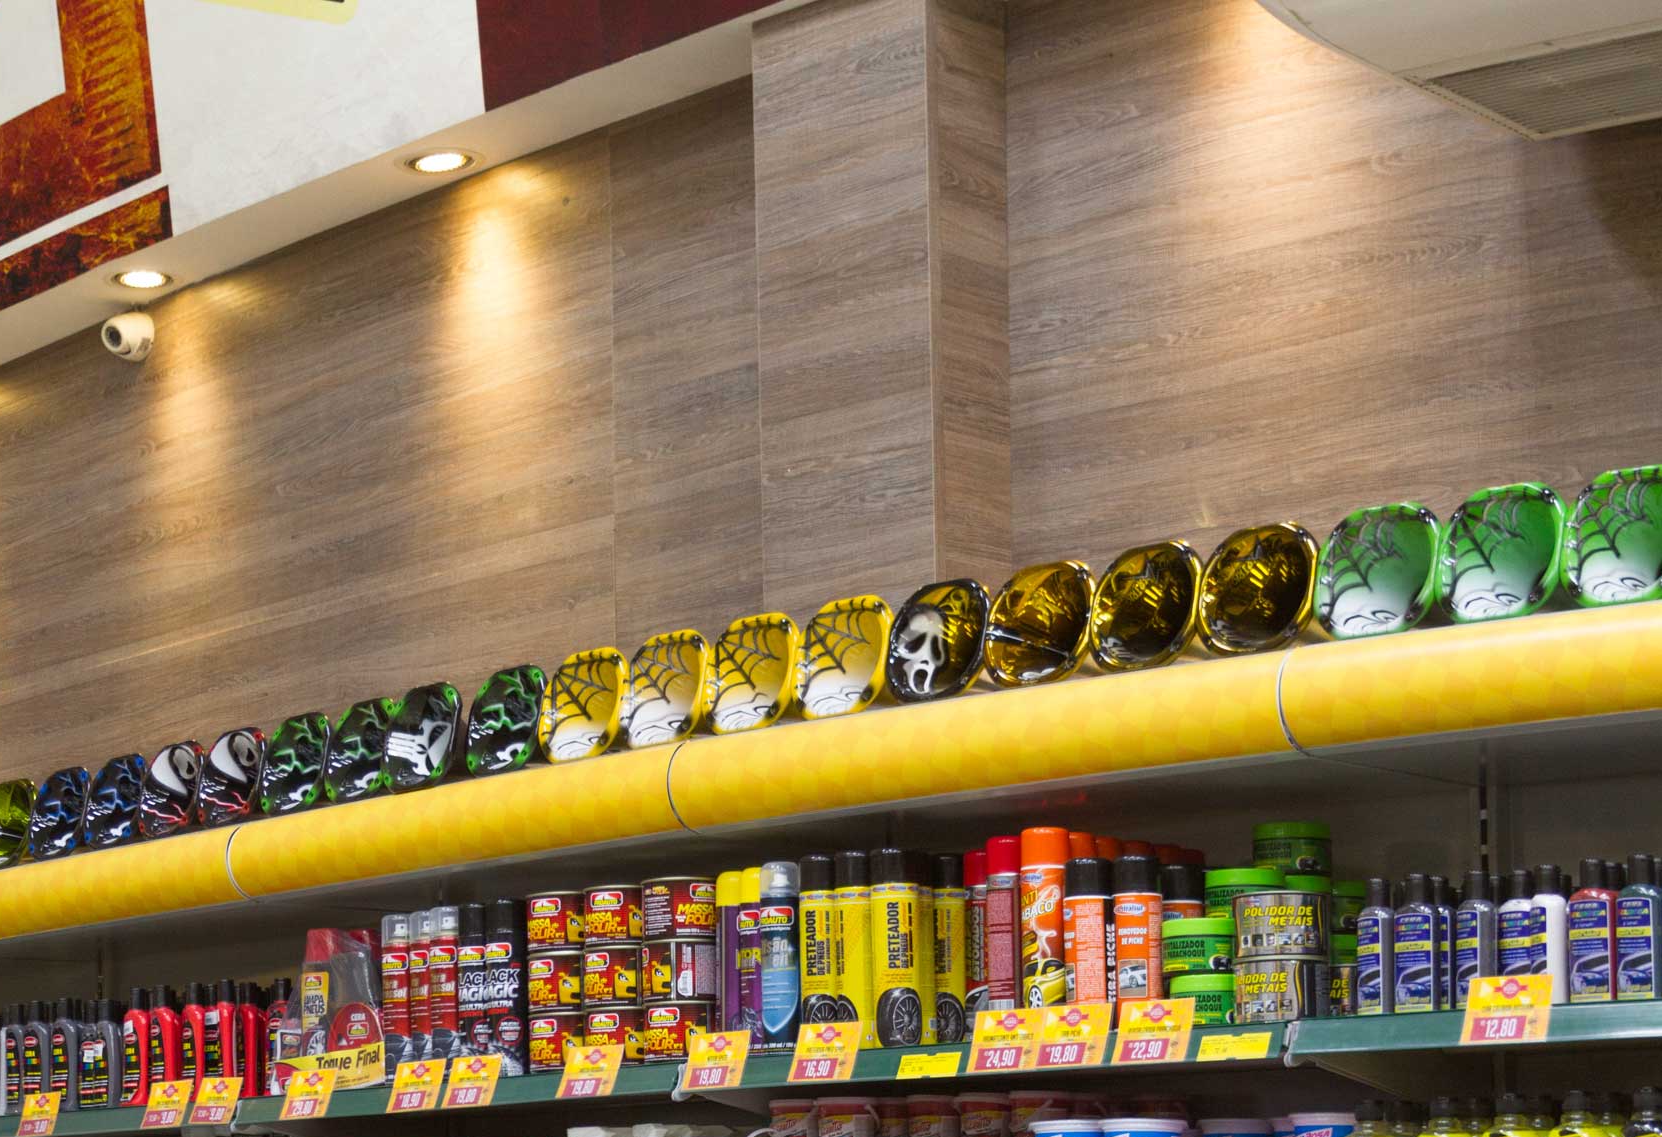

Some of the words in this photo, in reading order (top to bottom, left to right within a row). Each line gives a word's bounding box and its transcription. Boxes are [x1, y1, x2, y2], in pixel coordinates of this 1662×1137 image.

[1022, 900, 1054, 920] ABACO
[1244, 906, 1296, 918] POLIDOR
[1298, 905, 1313, 916] DE
[1269, 916, 1313, 927] METAIS
[805, 910, 817, 976] PRETEADOR
[887, 902, 900, 969] PRETEADOR
[488, 968, 520, 986] ACK
[1236, 972, 1269, 985] LIDOR
[1271, 972, 1287, 982] DE
[488, 984, 519, 999] AGIC
[1245, 982, 1287, 994] METAIS
[1330, 988, 1349, 999] AIS
[1485, 1017, 1517, 1040] 12,80
[356, 1045, 381, 1069] Final
[987, 1050, 1015, 1068] 24,90
[1049, 1045, 1076, 1062] 19,80
[1130, 1042, 1161, 1060] 22,90
[699, 1067, 721, 1085] 19,80
[805, 1060, 829, 1077] 16,90
